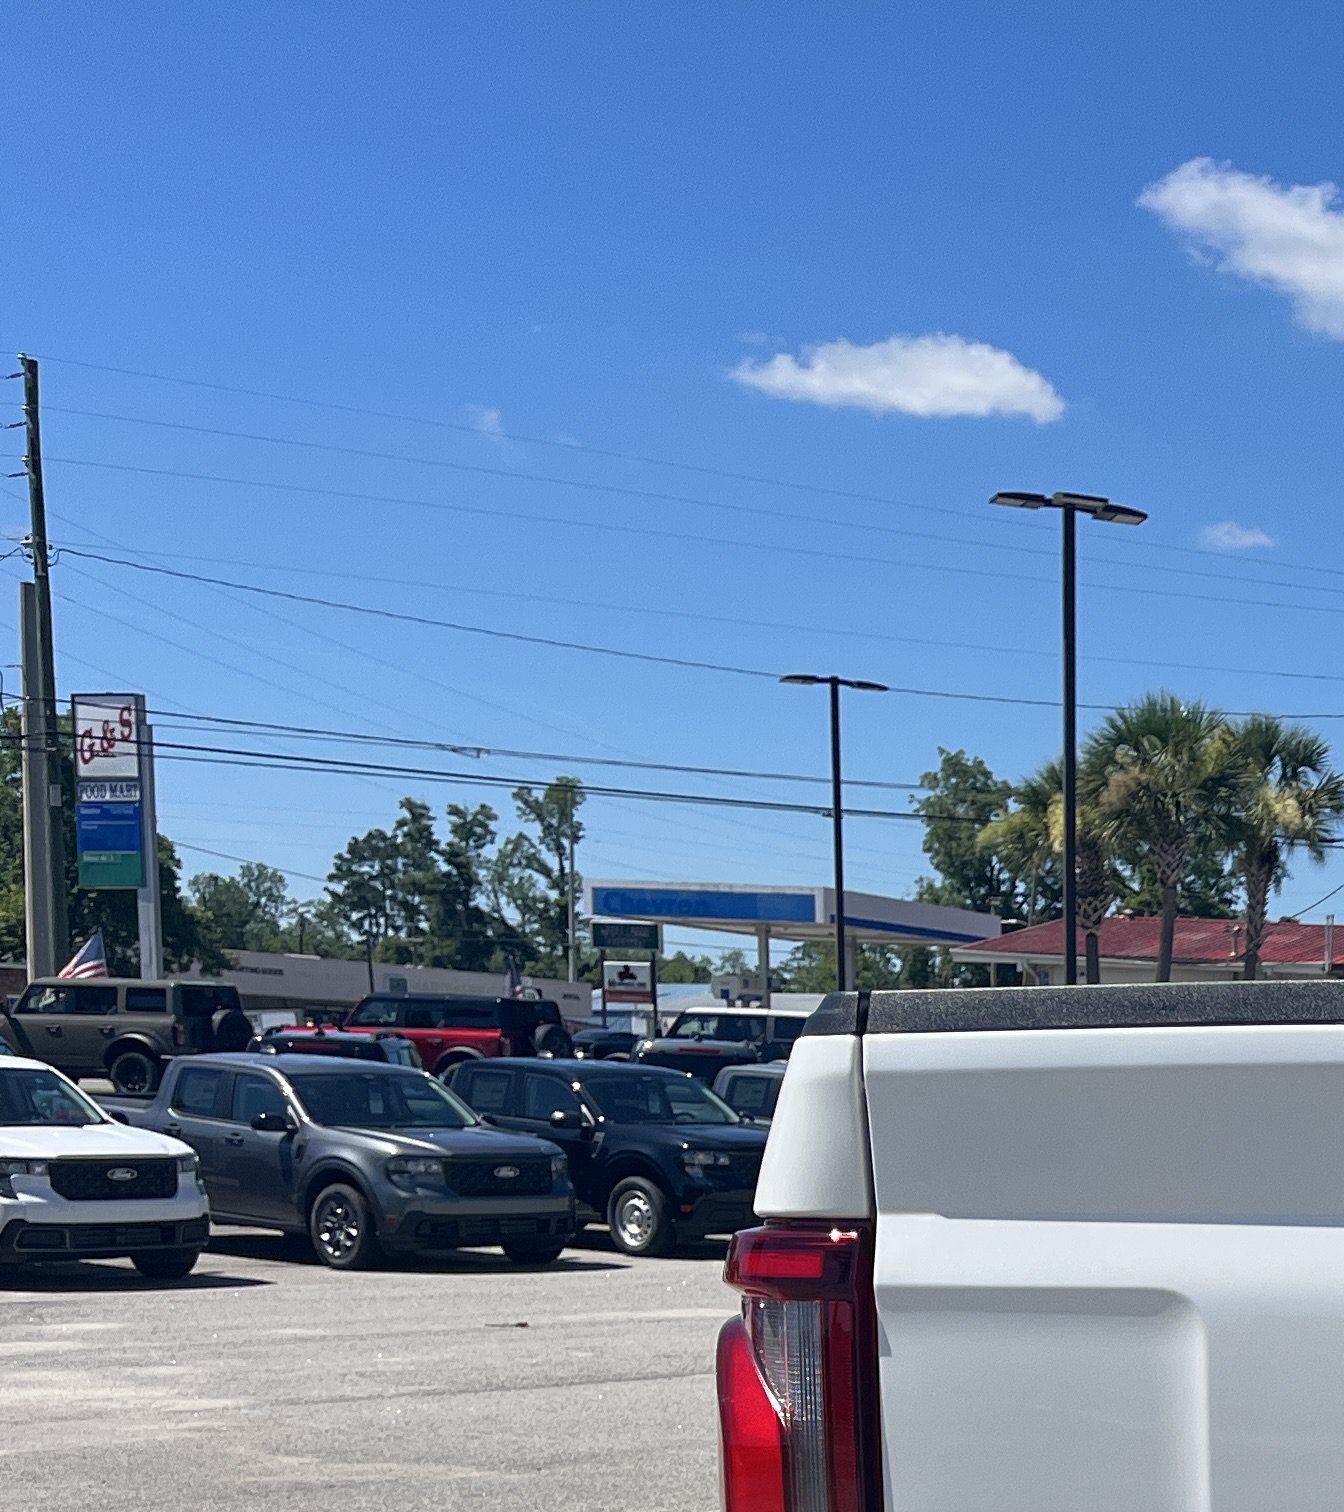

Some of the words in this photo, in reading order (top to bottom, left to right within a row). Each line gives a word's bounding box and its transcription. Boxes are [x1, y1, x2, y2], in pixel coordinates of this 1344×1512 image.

[80, 728, 95, 765] G
[101, 720, 116, 753] &
[119, 704, 133, 742] S
[79, 784, 108, 801] FOOD
[109, 784, 139, 799] MART
